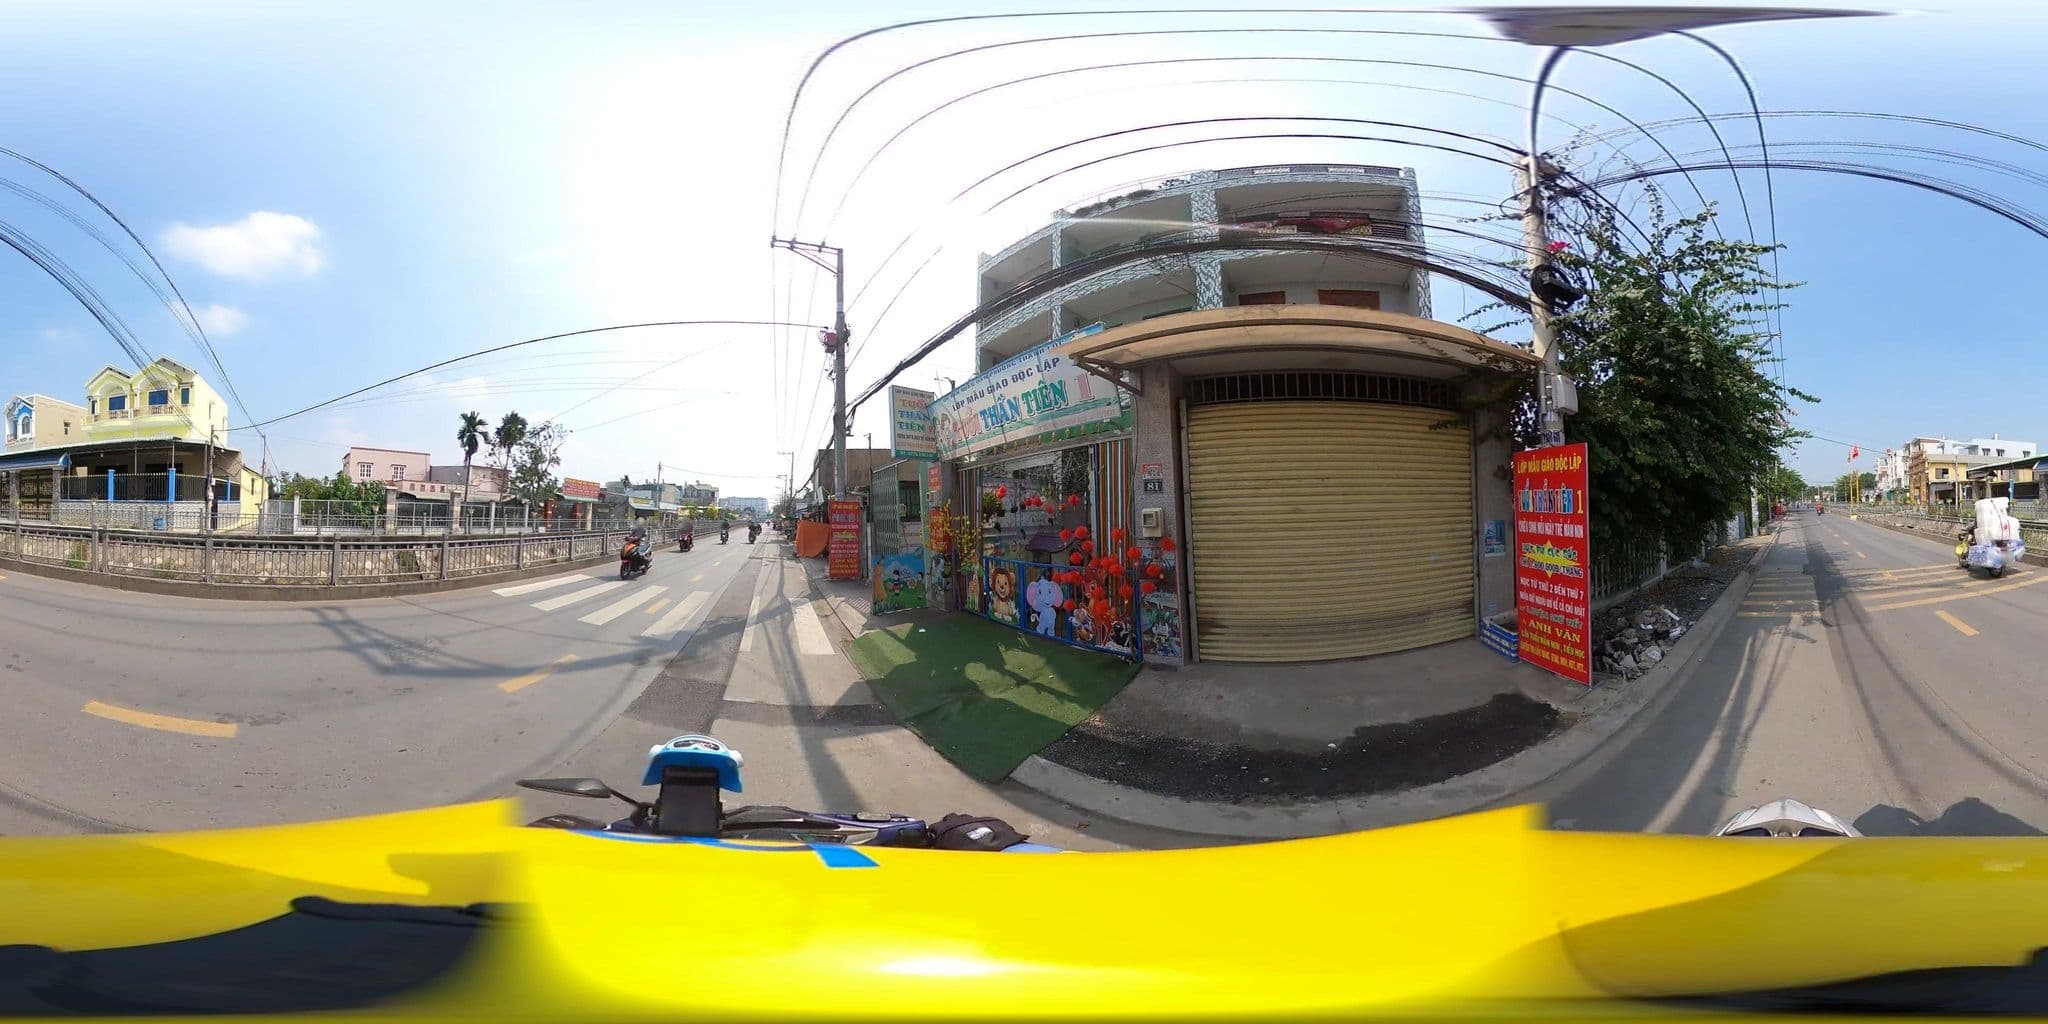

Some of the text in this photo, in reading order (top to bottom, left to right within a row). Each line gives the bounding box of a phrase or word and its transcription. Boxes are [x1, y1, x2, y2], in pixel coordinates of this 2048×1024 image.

[1036, 356, 1061, 374] LẬP
[1021, 379, 1069, 416] TIÊN
[1077, 372, 1096, 403] 1
[897, 421, 925, 432] TIÊN
[1541, 456, 1554, 472] GIÁO
[1555, 453, 1568, 473] ĐỘC
[1569, 452, 1582, 472] LẬP
[1147, 482, 1160, 491] 81
[1576, 489, 1584, 514] 1
[1549, 584, 1553, 593] 2
[1579, 591, 1584, 601] 7
[1529, 619, 1581, 644] ANH VĂN
